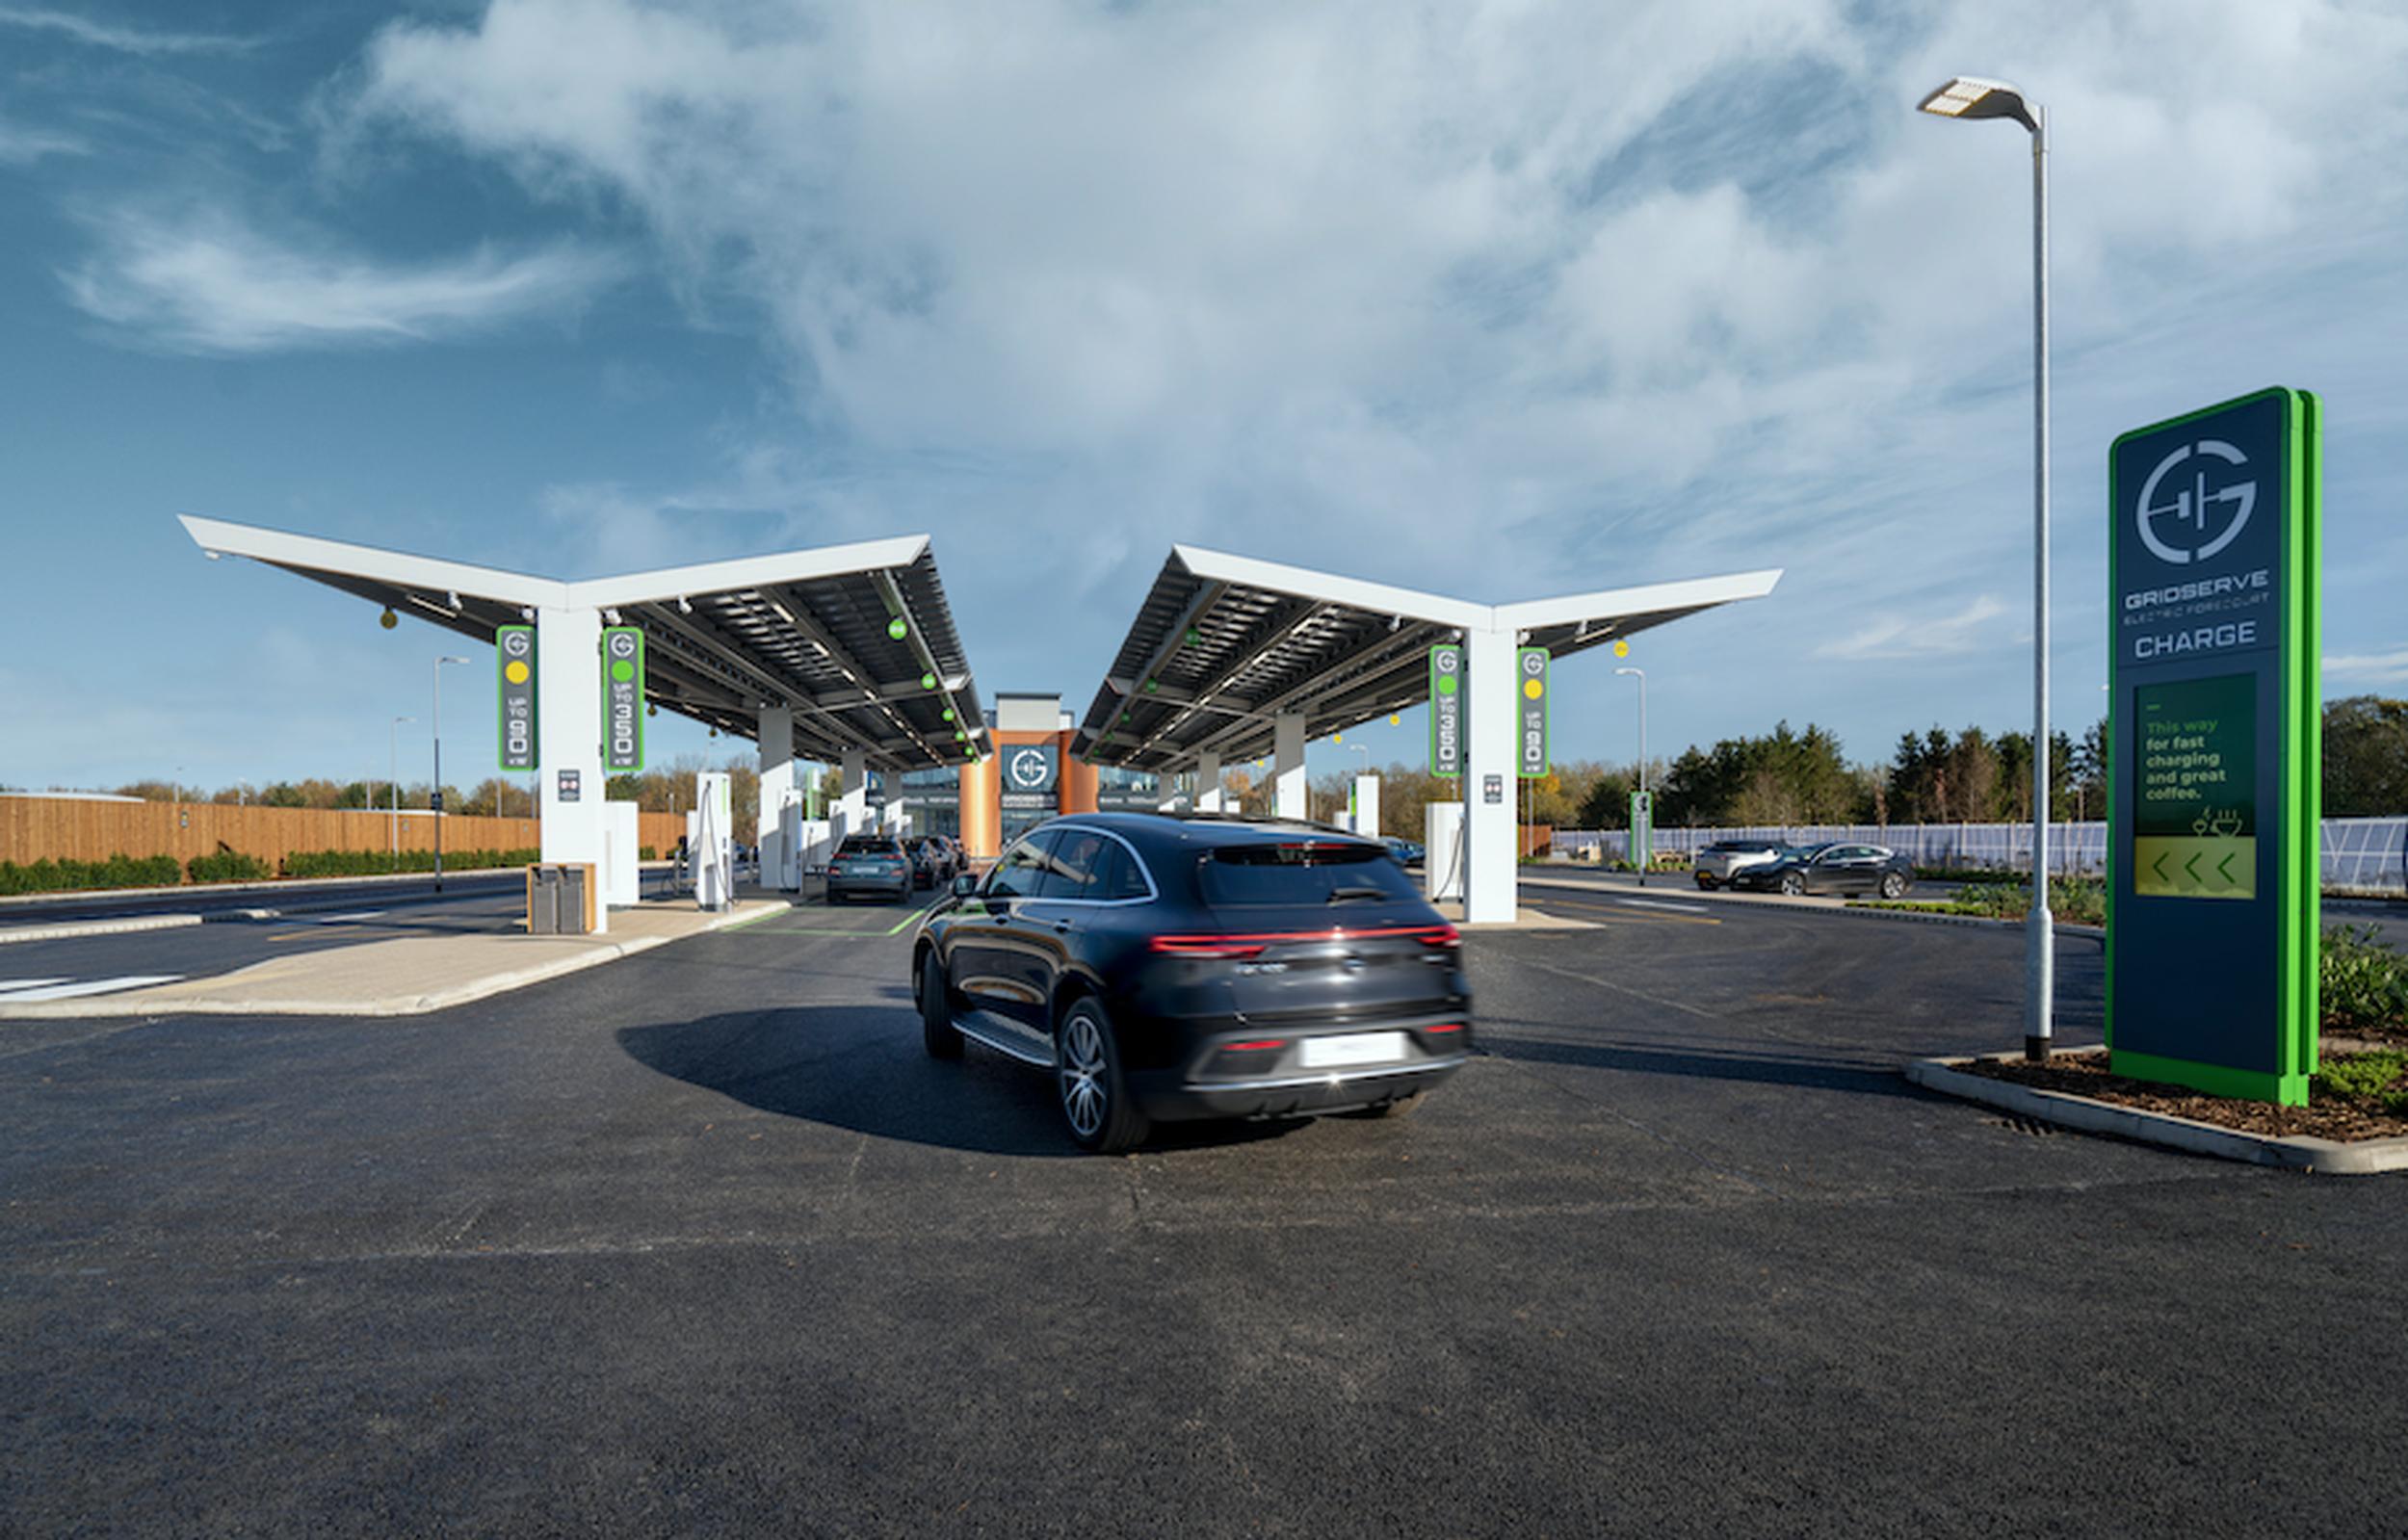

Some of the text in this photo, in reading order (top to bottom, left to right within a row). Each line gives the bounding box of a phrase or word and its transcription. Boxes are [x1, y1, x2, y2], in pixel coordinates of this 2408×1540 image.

[2125, 569, 2269, 610] GRIDSERVE
[2134, 621, 2257, 658] CHARGE
[509, 719, 528, 753] 90
[615, 704, 633, 754] 350
[1440, 714, 1455, 761] 350
[2146, 736, 2204, 750] for fast
[2147, 719, 2218, 735] This way
[1526, 730, 1541, 762] 90
[2146, 751, 2220, 769] charging
[2146, 769, 2226, 786] and great
[2146, 786, 2202, 800] coffee.
